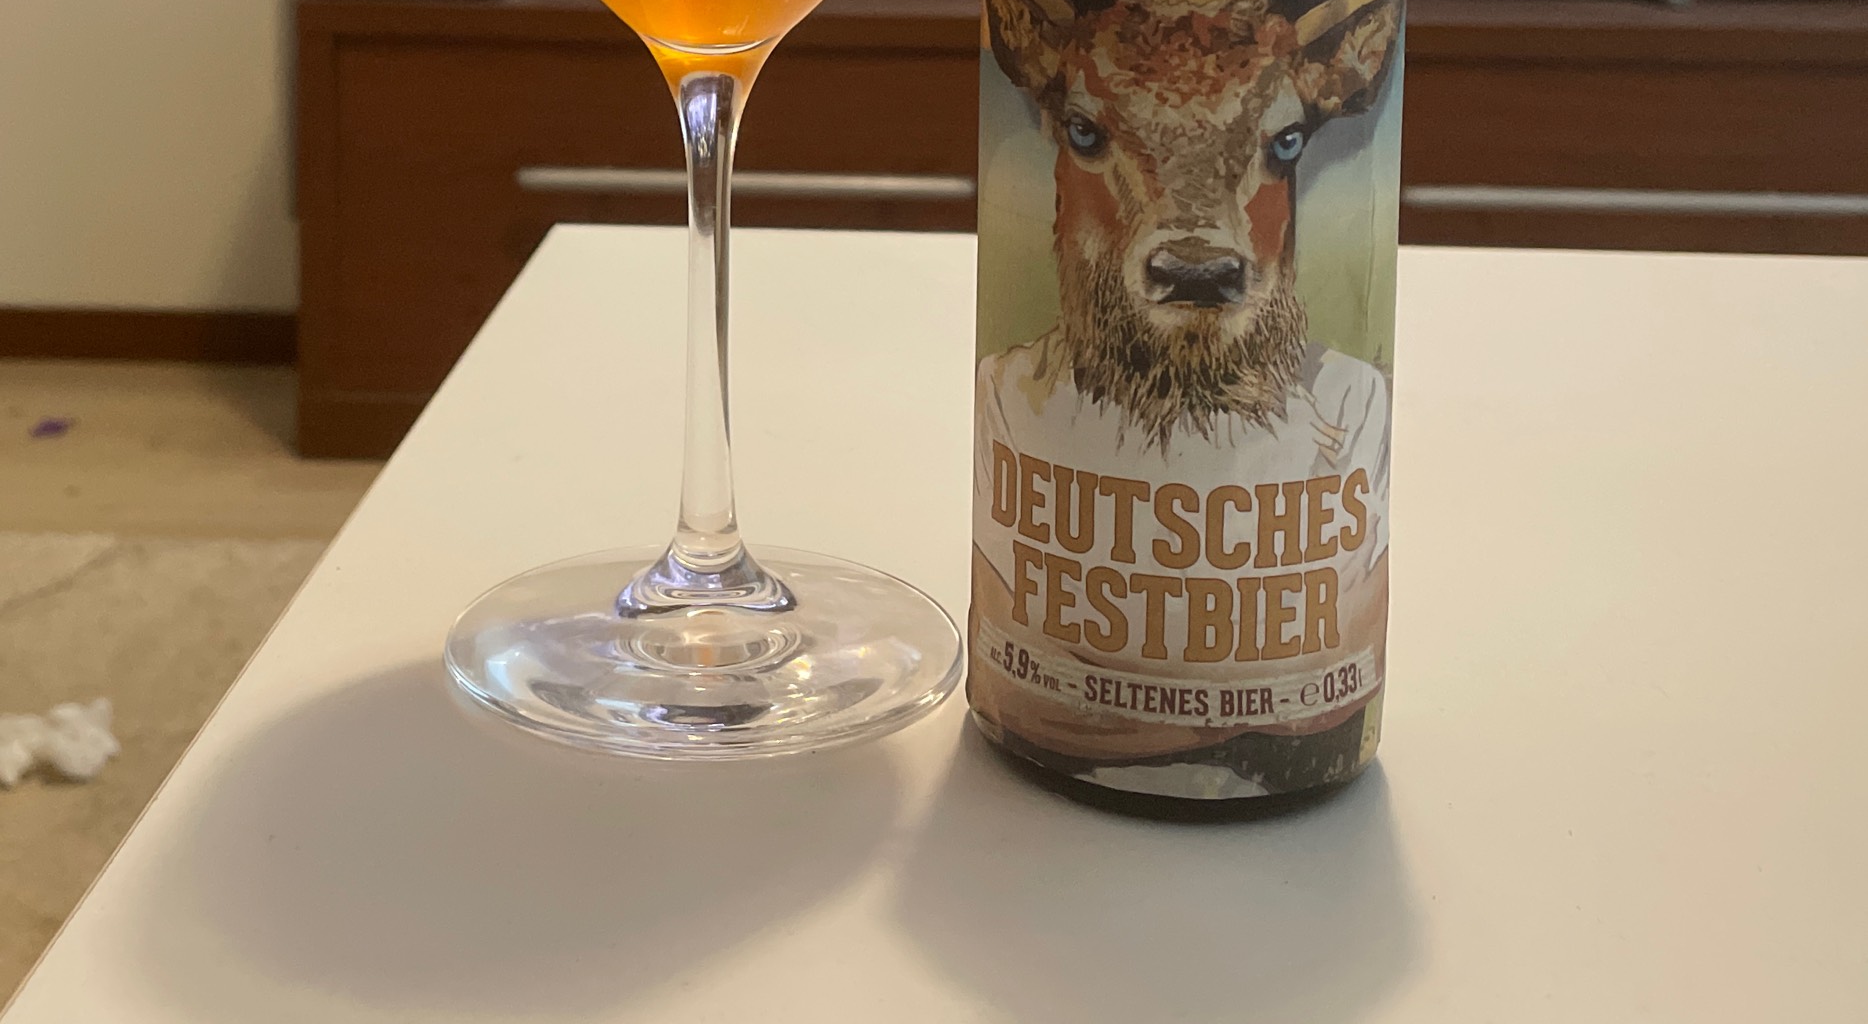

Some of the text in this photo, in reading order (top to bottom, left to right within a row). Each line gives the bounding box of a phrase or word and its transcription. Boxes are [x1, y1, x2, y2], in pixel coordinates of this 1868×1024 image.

[991, 439, 1370, 570] DEUTSCHES
[1011, 539, 1340, 663] FESTBIER
[1003, 640, 1041, 684] 5,9%
[1084, 675, 1209, 717] SELTENES
[1219, 688, 1274, 718] BIER
